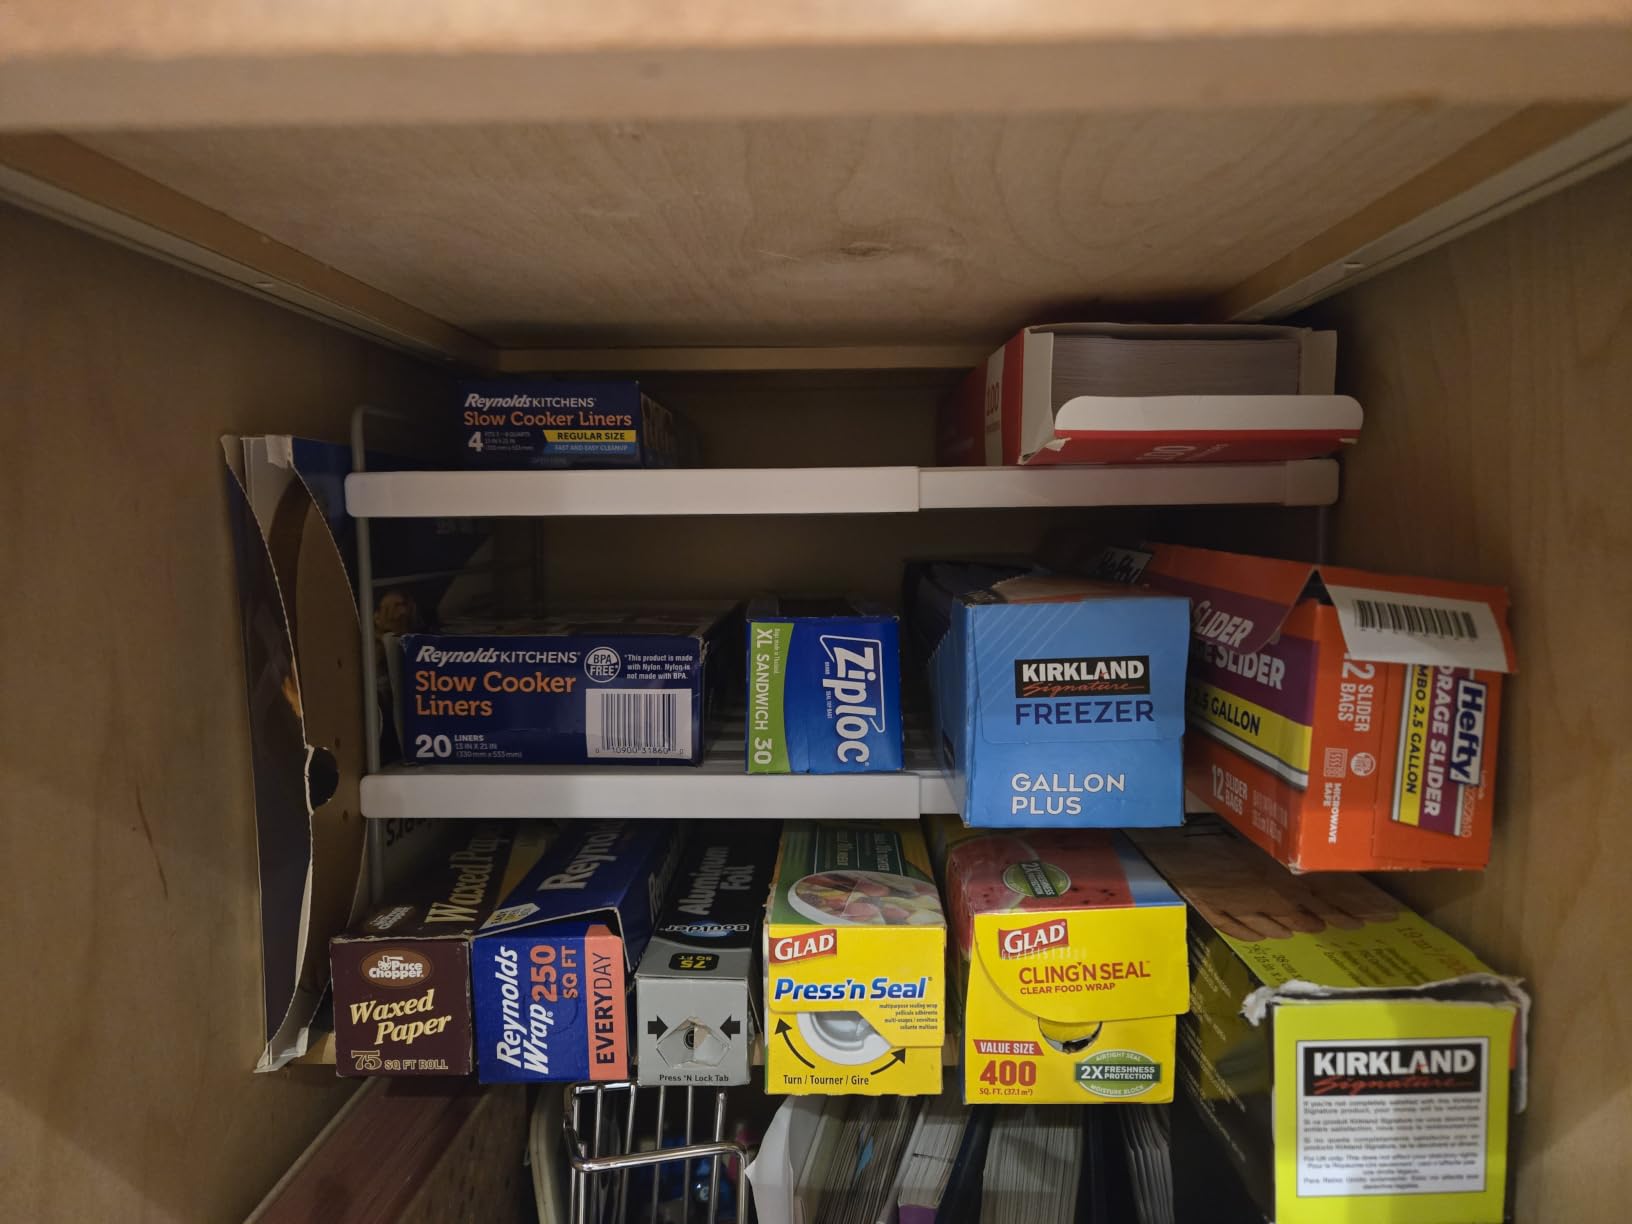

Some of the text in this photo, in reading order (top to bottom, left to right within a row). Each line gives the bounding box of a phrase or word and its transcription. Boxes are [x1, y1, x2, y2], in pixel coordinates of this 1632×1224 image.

[464, 393, 597, 411] Reynolds KITCHENS
[464, 411, 633, 426] Slow Cooker Liners
[468, 431, 485, 452] 4
[557, 432, 626, 441] REGULAR SIZE
[1193, 599, 1254, 648] SLIDER
[416, 646, 580, 667] Reynolds KITCHENS
[593, 654, 613, 665] BPA
[627, 663, 641, 671] with
[642, 663, 662, 672] Nylon.
[665, 663, 683, 672] Nylon
[643, 654, 667, 662] product
[668, 654, 674, 662] is
[1022, 660, 1145, 682] KIRKLAND
[1216, 646, 1286, 690] SLIDER
[415, 671, 577, 693] Slow Cooker
[1022, 681, 1145, 698] Signature
[415, 695, 494, 717] Liners
[754, 628, 773, 765] XL SANDWICH 30
[822, 647, 878, 764] Ziploc
[1338, 683, 1355, 722] BAGS
[1016, 700, 1155, 726] FREEZER
[1211, 697, 1261, 737] GALLON
[1354, 683, 1374, 733] SLIDER
[1411, 705, 1425, 728] 2.5
[454, 735, 485, 743] LINERS
[1451, 683, 1484, 782] Hefty
[415, 734, 453, 759] 20
[1405, 732, 1422, 795] GALLON
[1011, 773, 1126, 793] GALLON
[1212, 764, 1225, 802] 12
[1424, 739, 1447, 817] SLIDER
[1011, 796, 1083, 816] PLUS
[1323, 783, 1333, 807] SAFE
[1328, 783, 1342, 844] MICROWAVE
[677, 846, 729, 916] Aluminum
[720, 864, 756, 891] Foil
[664, 924, 750, 933] Boulder
[1004, 924, 1065, 954] GLAD
[774, 933, 834, 961] GLAD
[369, 967, 423, 980] Chopper
[391, 960, 423, 971] Price
[530, 945, 558, 1003] 250
[561, 945, 578, 999] SQ FT
[680, 960, 707, 969] 75
[1101, 962, 1150, 981] SEAL
[774, 976, 927, 1001] Press'n Seal
[1020, 983, 1116, 995] CLEAR FOOD WRAP
[349, 988, 435, 1025] Waxed
[495, 945, 528, 1068] Reynolds
[593, 952, 615, 1064] EVERYDAY
[374, 1015, 452, 1045] Paper
[523, 1004, 554, 1075] Wrap
[980, 1042, 1034, 1054] VALUE SIZE
[1095, 1052, 1141, 1061] AIRTIGHT SEAL
[351, 1050, 449, 1071] 75 SQ FT ROLL
[1313, 1049, 1476, 1076] KIRKLAND
[659, 1074, 681, 1082] Press
[694, 1074, 713, 1082] Lock
[714, 1074, 729, 1082] Tab
[784, 1075, 869, 1085] Turn / Tourner / Gire
[980, 1060, 1036, 1086] 400
[1081, 1066, 1103, 1079] 2X
[979, 1088, 991, 1096] SQ.
[1091, 1085, 1144, 1095] MOISTURE BLOCK
[1312, 1075, 1473, 1096] Signature
